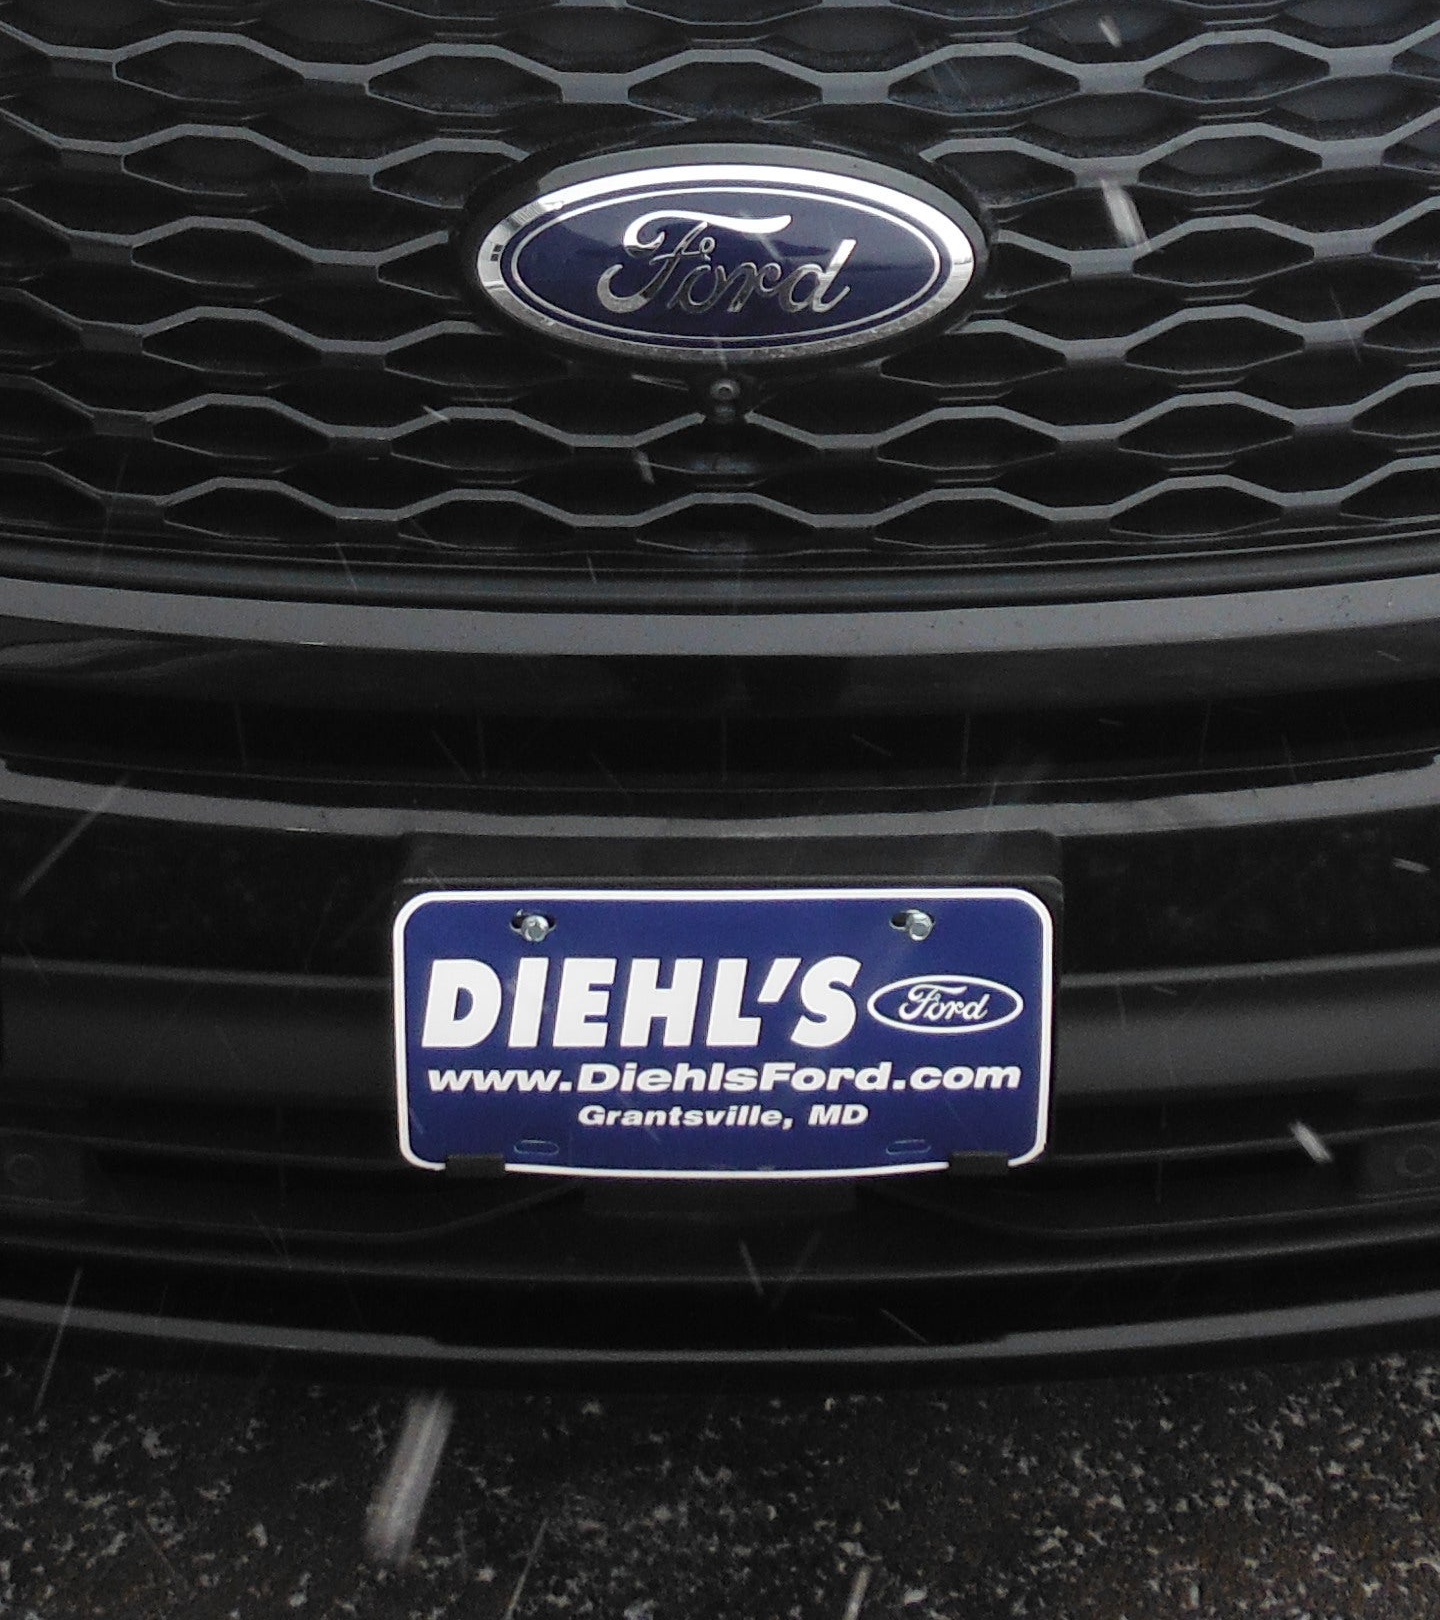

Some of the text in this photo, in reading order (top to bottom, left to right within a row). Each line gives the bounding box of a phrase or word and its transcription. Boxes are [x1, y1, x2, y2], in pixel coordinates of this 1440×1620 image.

[597, 209, 857, 314] Ford
[421, 956, 989, 1049] DIEHL'S Ford
[427, 1061, 1021, 1093] www.DiehlsFord.com
[577, 1103, 869, 1130] Grantsville, MD
